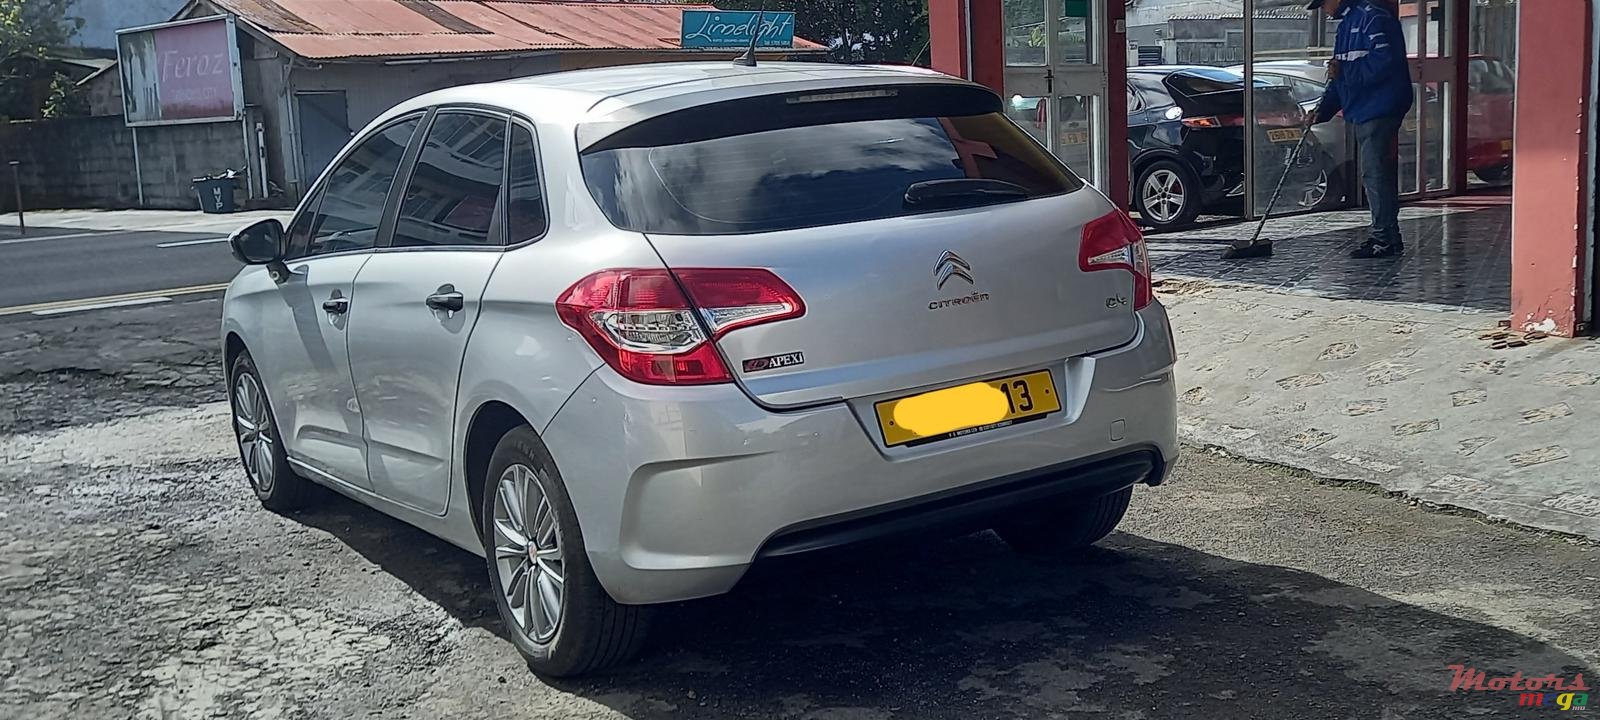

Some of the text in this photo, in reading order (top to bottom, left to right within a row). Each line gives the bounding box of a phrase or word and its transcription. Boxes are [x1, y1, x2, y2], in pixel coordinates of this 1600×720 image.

[685, 13, 792, 43] Limelight
[162, 51, 223, 82] Feroz
[213, 187, 224, 210] MVP
[1001, 379, 1034, 414] 13
